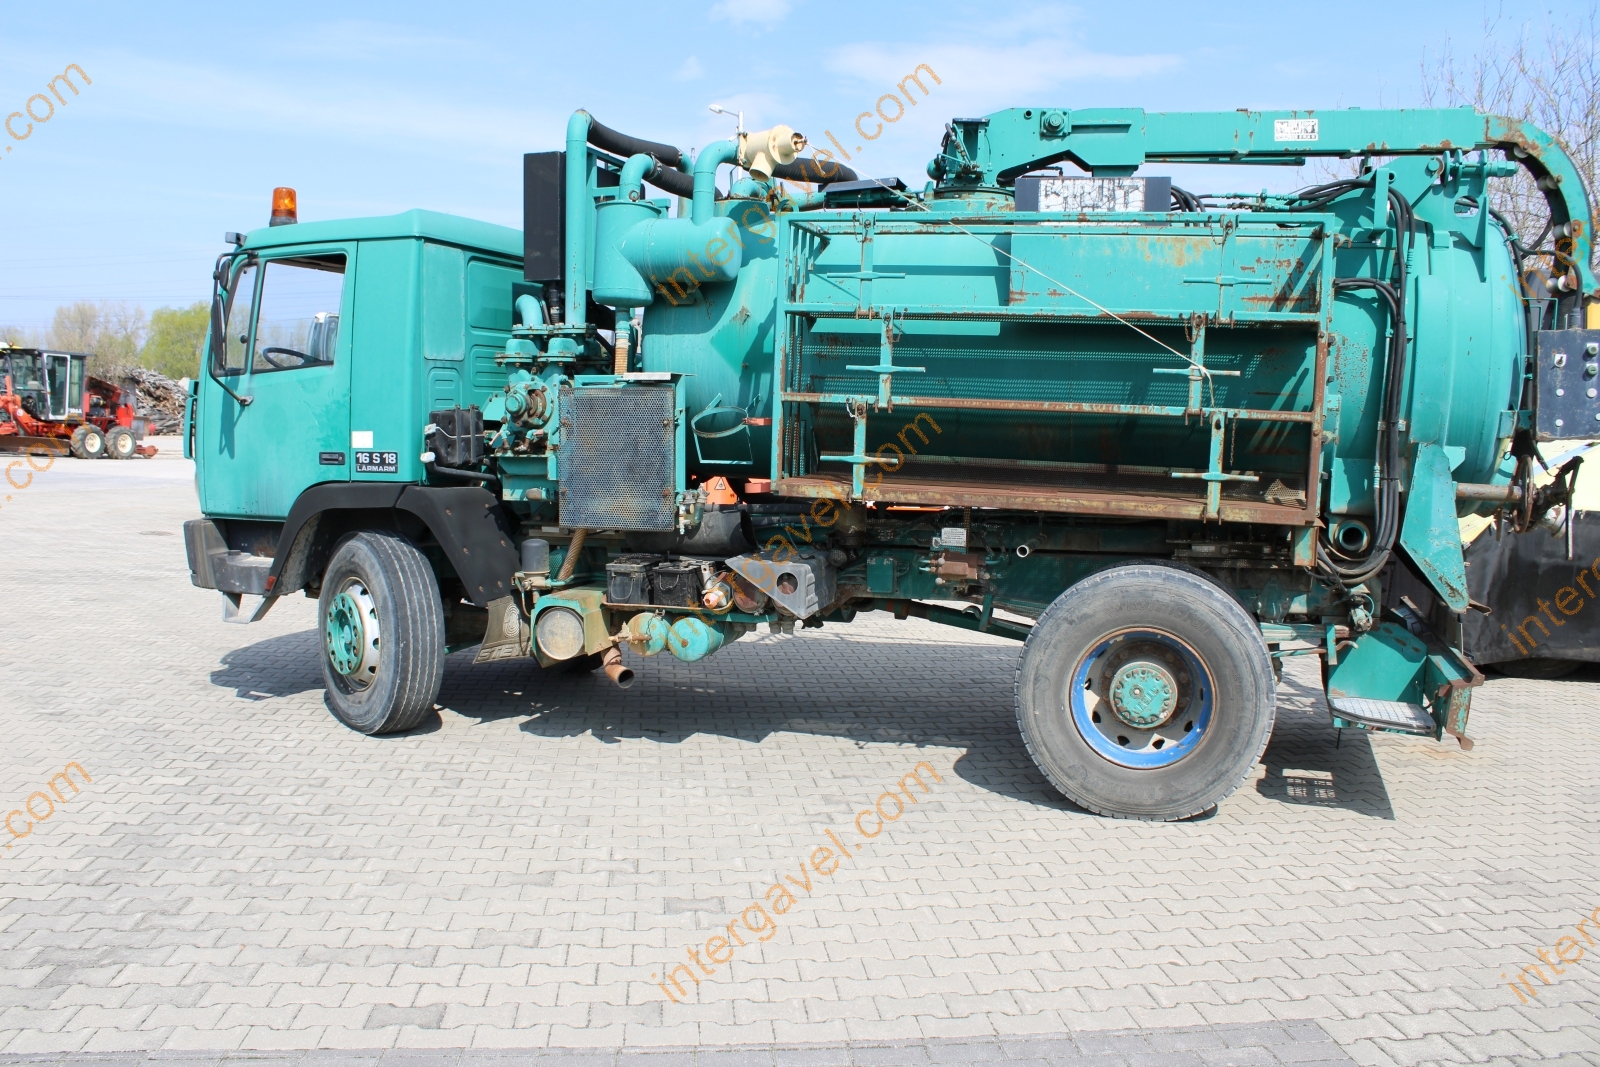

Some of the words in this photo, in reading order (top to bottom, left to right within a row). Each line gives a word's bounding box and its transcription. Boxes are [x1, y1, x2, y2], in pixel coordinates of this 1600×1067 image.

[356, 453, 370, 464] 16
[372, 453, 380, 464] S
[383, 453, 397, 464] 18
